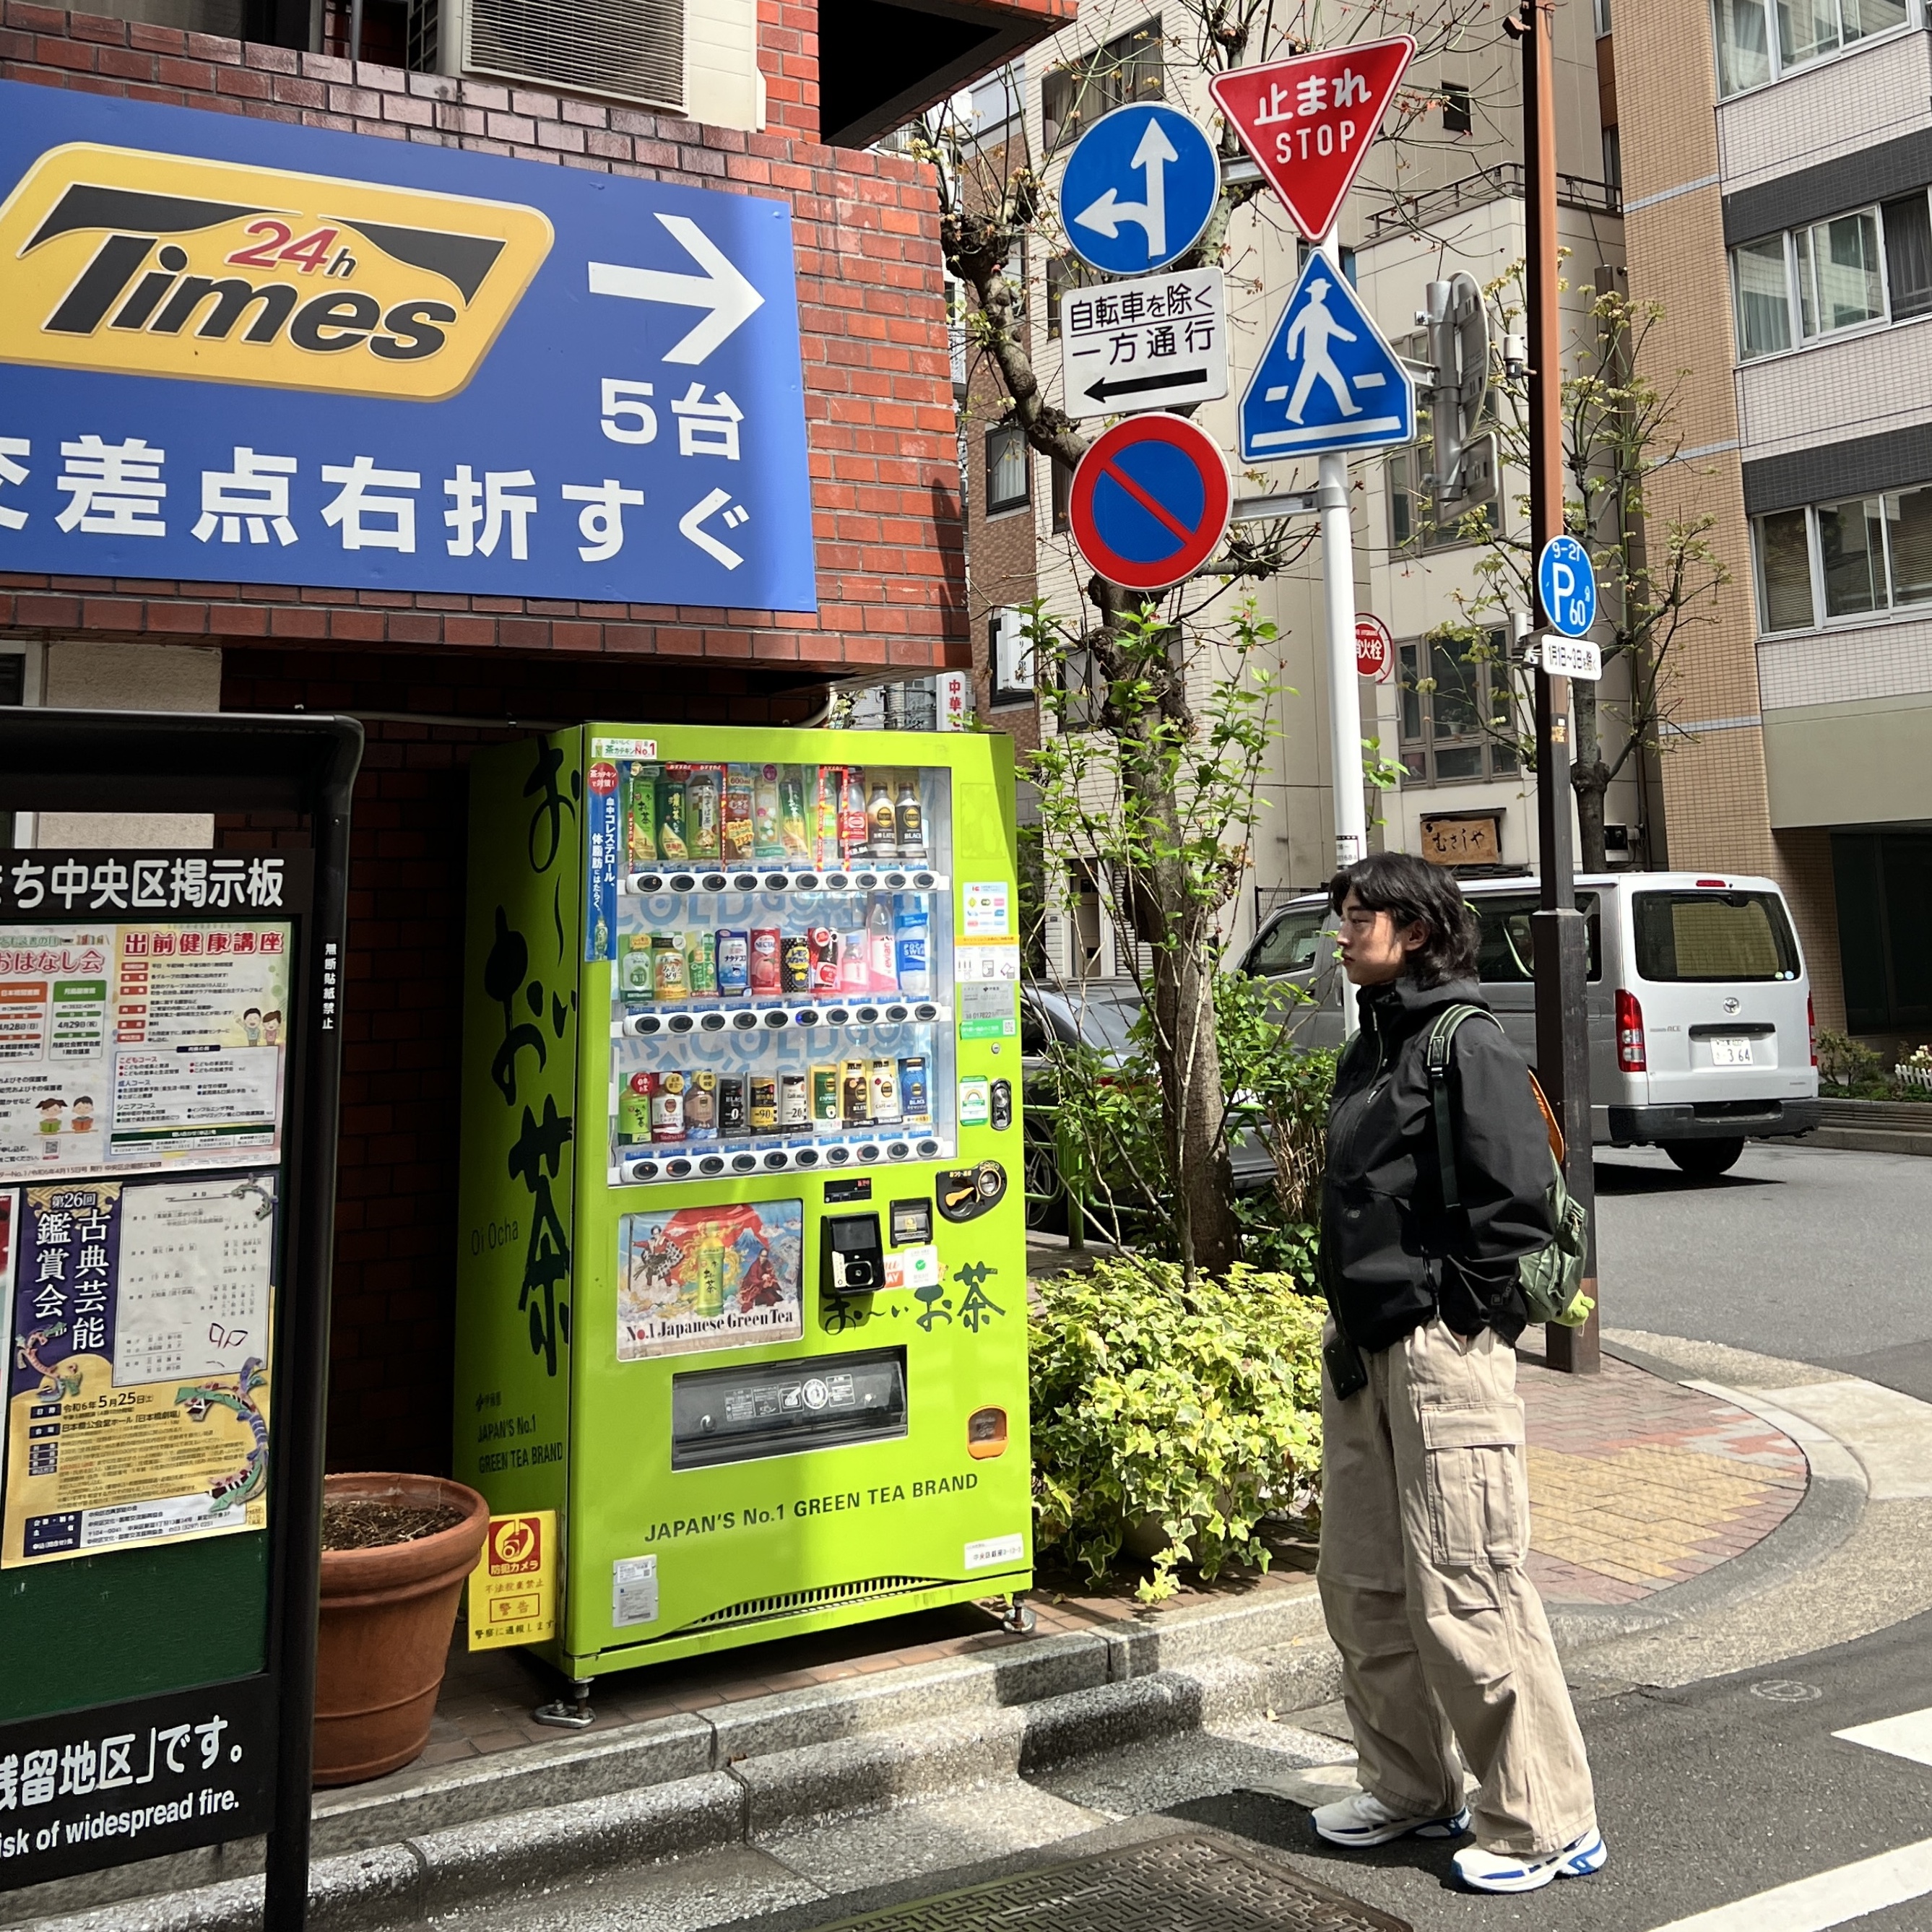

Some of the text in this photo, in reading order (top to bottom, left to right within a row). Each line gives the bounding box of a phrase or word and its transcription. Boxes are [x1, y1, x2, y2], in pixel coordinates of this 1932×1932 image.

[1253, 68, 1372, 126] 止まれ
[1275, 120, 1356, 164] STOP
[225, 218, 357, 279] 24h
[40, 233, 458, 363] Times
[1070, 284, 1214, 332] 自転車を除く
[1072, 319, 1216, 365] 一方通行
[600, 378, 745, 461] 5台
[1551, 541, 1581, 562] 9-21
[1553, 562, 1575, 623] P
[0, 858, 285, 910] ち中央区掲示板
[124, 931, 285, 956] 出前健康講座
[51, 1190, 97, 1210] 第26回
[470, 1218, 519, 1257] Oi Ocha
[33, 1212, 74, 1320] 鑑賞会
[72, 1211, 112, 1351] 古典芸能
[657, 1318, 725, 1339] Japanese
[727, 1312, 768, 1329] Green
[768, 1309, 793, 1324] Tea
[516, 1413, 536, 1436] No.1
[478, 1442, 563, 1474] GREEN TEA BRAND
[644, 1472, 979, 1543] JAPAN'S No.1 GREEN TEA BRAND
[490, 1559, 539, 1576] 防犯カメラ
[474, 1619, 555, 1640] 警察に通報します
[498, 1599, 529, 1617] 警告
[35, 1819, 61, 1851] of
[66, 1792, 194, 1845] widespread
[199, 1788, 239, 1816] fire.
